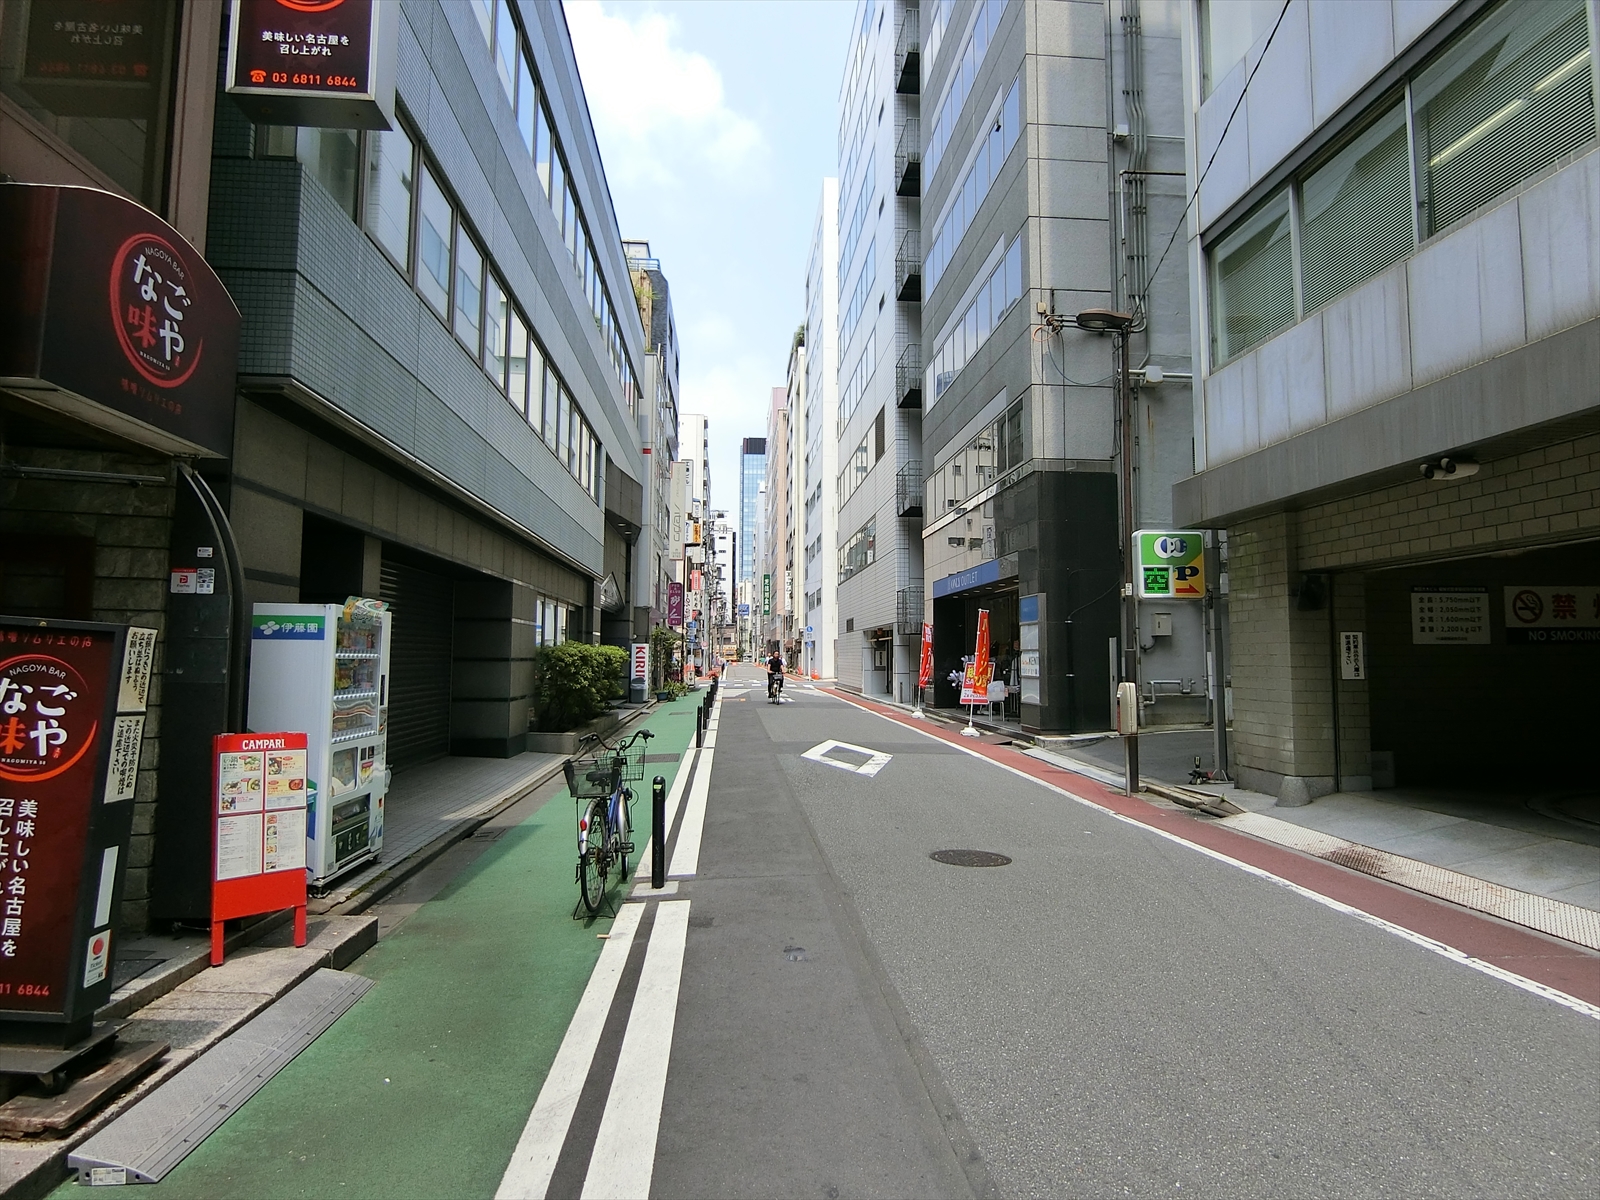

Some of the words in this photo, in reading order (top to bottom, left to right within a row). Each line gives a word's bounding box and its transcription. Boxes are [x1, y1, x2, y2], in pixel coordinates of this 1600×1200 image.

[262, 31, 350, 46] 美味しい名古屋を
[279, 44, 332, 56] 召し上がれ
[272, 73, 287, 83] 03
[293, 74, 321, 85] 6811
[326, 75, 357, 87] 6844
[145, 247, 172, 265] NAGOYA
[172, 261, 185, 280] BAR
[1144, 568, 1170, 594] 空
[1175, 566, 1200, 581] P
[281, 622, 318, 633] 伊藤園
[1528, 630, 1547, 641] NO
[125, 631, 140, 685] お願いします
[9, 664, 47, 677] NAGOYA
[48, 666, 67, 680] BAR
[242, 738, 285, 750] CAMPARI
[1, 799, 38, 958] 美味しい名古屋を
[17, 984, 51, 997] 6844
